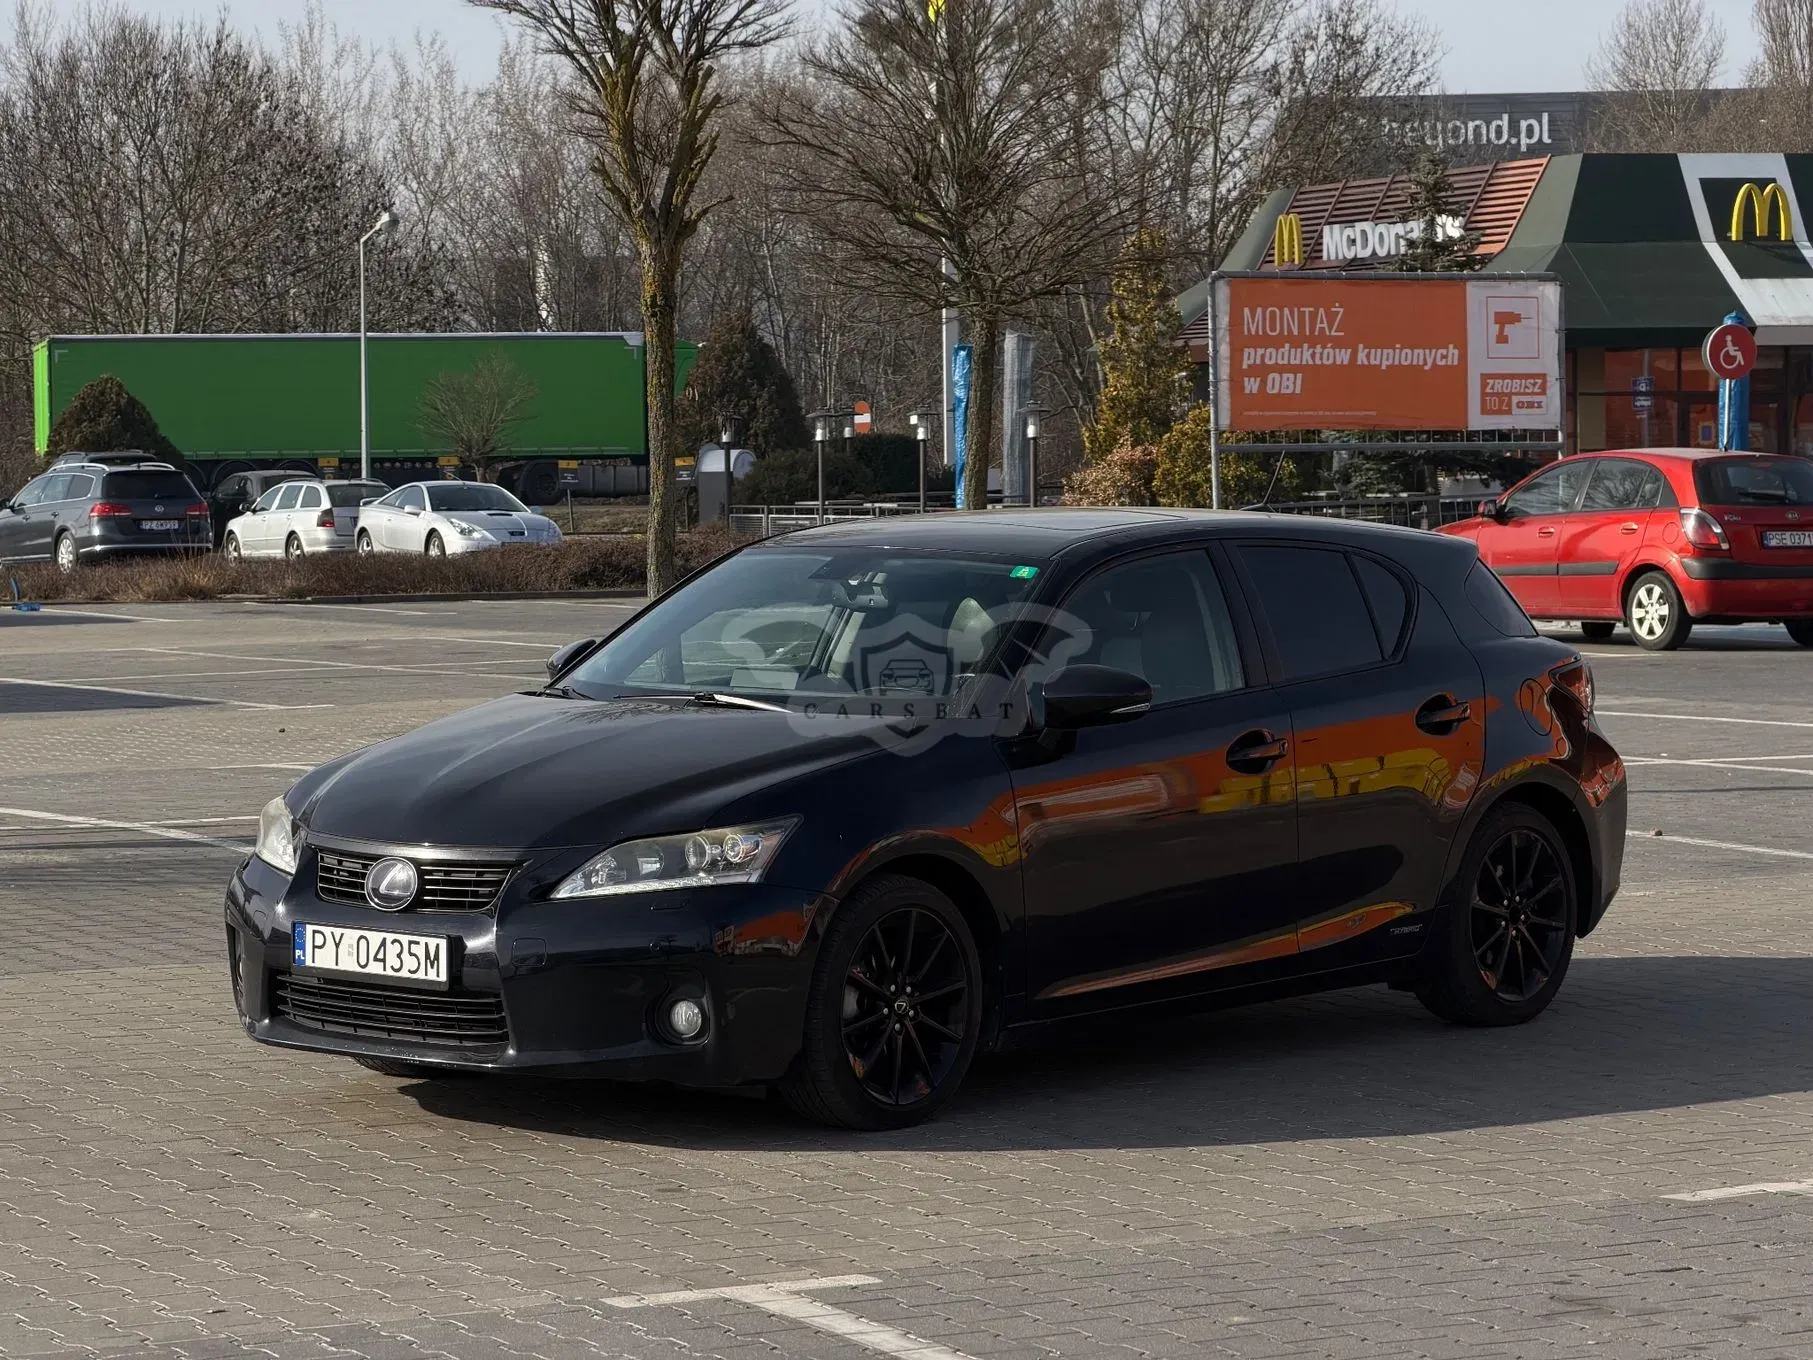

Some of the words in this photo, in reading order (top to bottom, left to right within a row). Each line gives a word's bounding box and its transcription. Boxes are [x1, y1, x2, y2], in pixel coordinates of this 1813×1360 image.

[1322, 213, 1465, 261] McDona's
[1243, 302, 1345, 336] MONTAŻ
[1242, 343, 1352, 369] produktów
[1357, 343, 1460, 370] kupionych
[1243, 376, 1261, 394] w
[1266, 372, 1303, 394] OBI
[1485, 378, 1543, 393] ZROBISZ
[1484, 396, 1499, 410] TO
[1501, 396, 1509, 410] Z
[1768, 533, 1788, 545] PSE
[1789, 533, 1813, 545] 0371
[295, 949, 305, 960] PL
[311, 929, 345, 967] PY
[356, 934, 440, 978] 0435M
